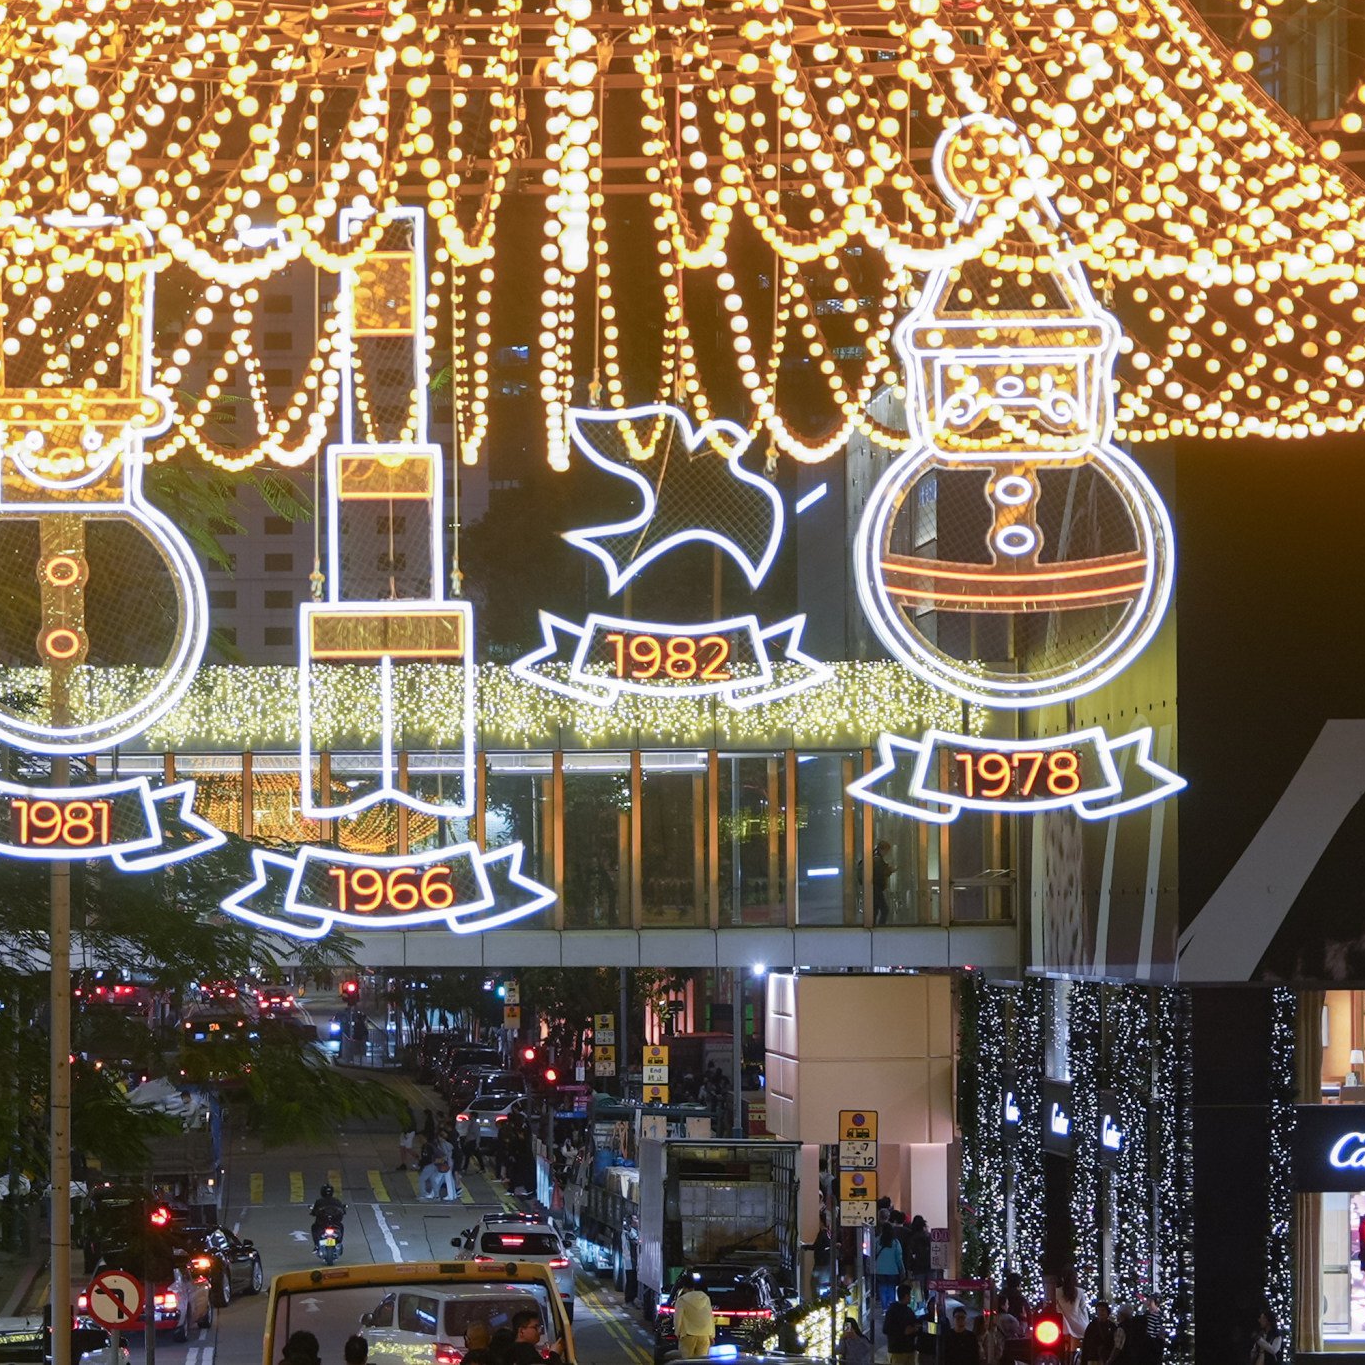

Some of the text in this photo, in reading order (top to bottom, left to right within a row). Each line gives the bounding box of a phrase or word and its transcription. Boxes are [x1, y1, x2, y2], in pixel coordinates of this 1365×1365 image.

[605, 634, 731, 680] 1982
[955, 751, 1080, 797] 1978
[11, 800, 110, 846] 1981
[329, 867, 455, 912] 1966
[863, 1157, 874, 1166] 12
